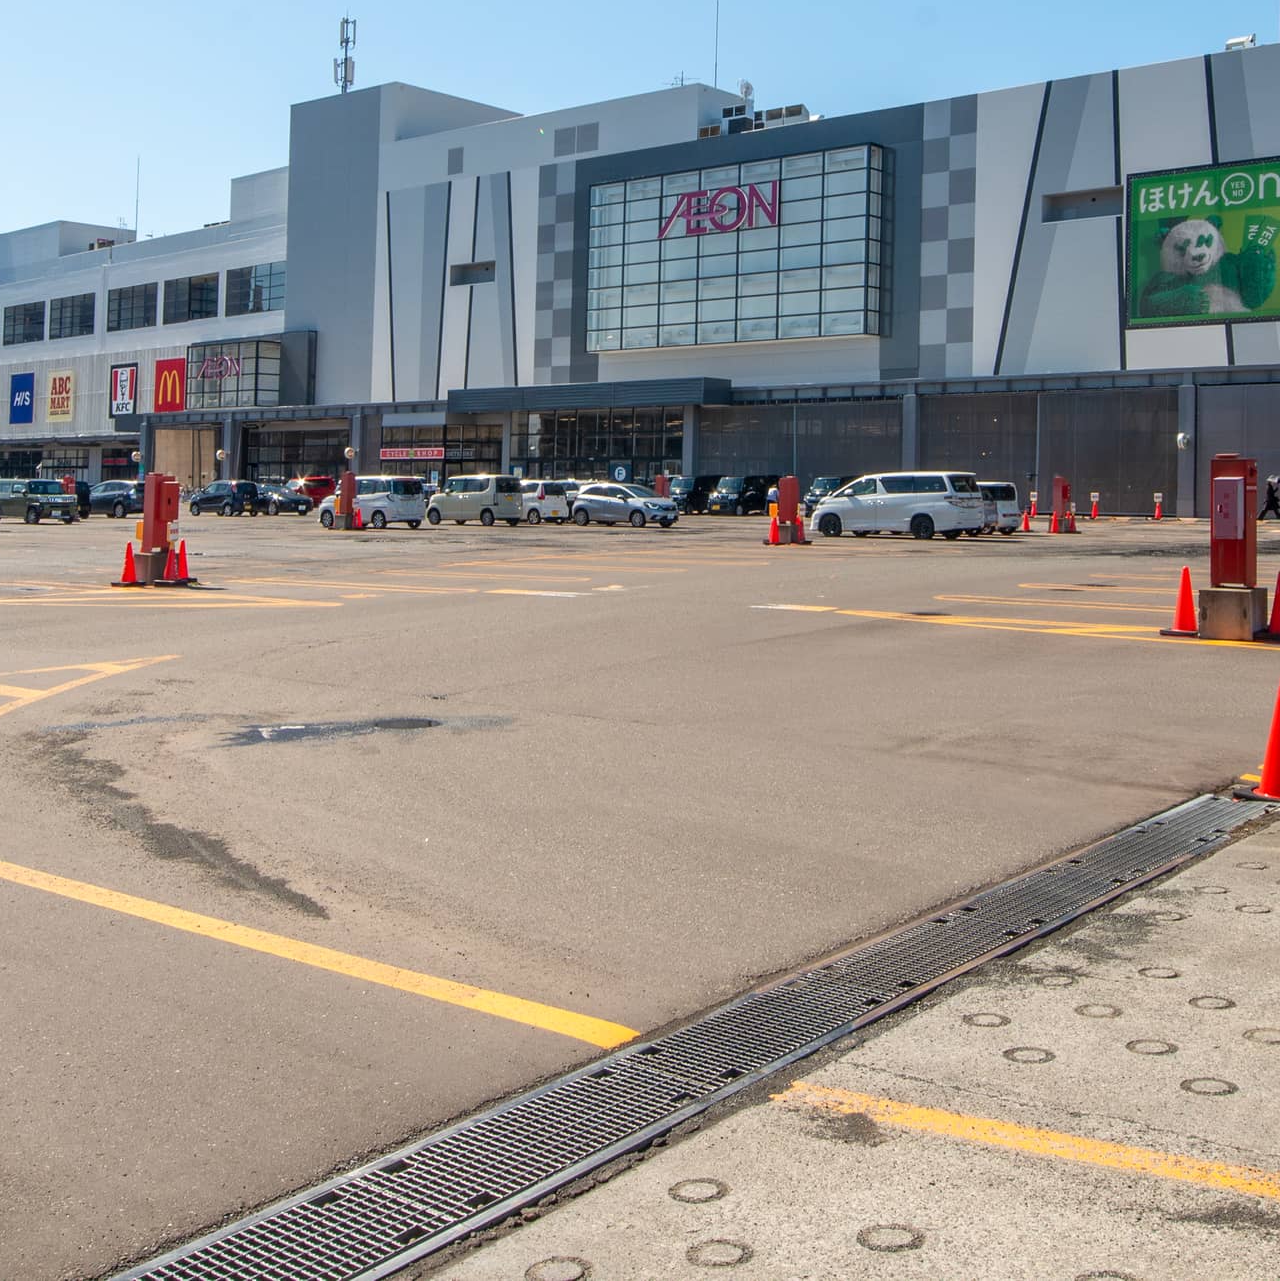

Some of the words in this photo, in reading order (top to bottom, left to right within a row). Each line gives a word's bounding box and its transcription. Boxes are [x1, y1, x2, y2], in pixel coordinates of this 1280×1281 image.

[1230, 180, 1245, 189] YES
[1139, 180, 1219, 213] ほけん
[1232, 189, 1244, 198] NO
[50, 376, 71, 396] ABC
[50, 396, 70, 409] MART
[115, 401, 131, 413] KFC
